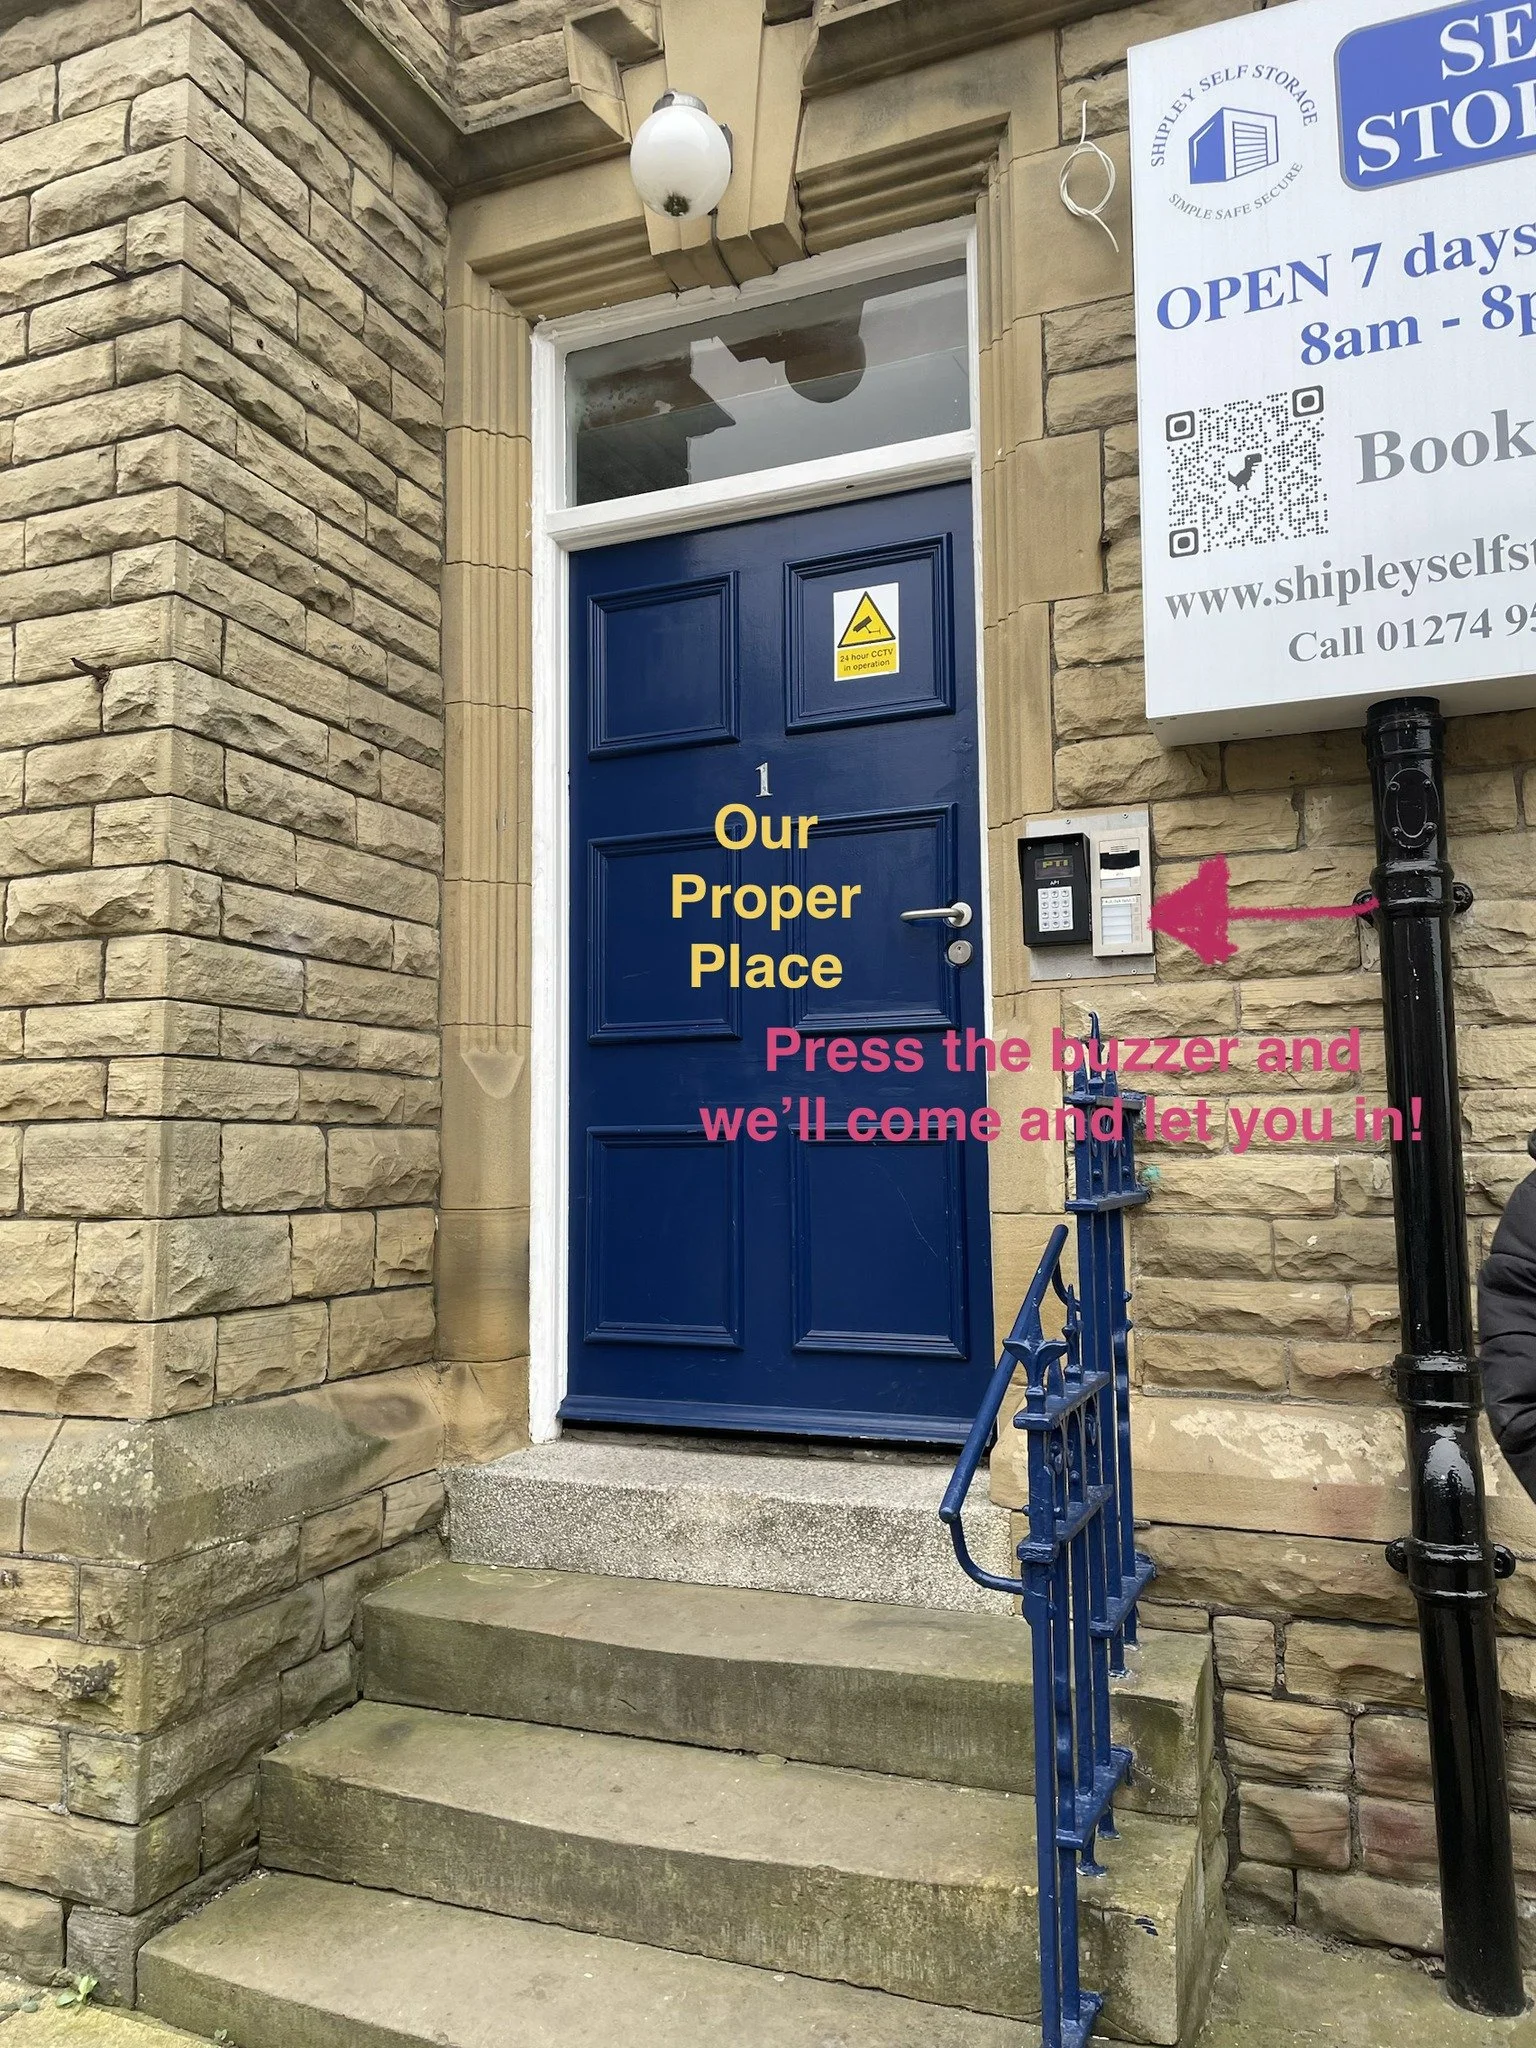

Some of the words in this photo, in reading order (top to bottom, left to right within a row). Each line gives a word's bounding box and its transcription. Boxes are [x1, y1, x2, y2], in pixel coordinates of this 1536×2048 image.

[1440, 3, 1536, 80] SE
[1151, 88, 1196, 167] SHIPLEY
[1199, 64, 1249, 92] SELF
[1252, 64, 1318, 127] STORAGE
[1168, 193, 1212, 220] SIMPLE
[1215, 203, 1252, 220] SAFE
[1254, 162, 1303, 209] SECURE
[1156, 253, 1332, 330] OPEN
[1351, 242, 1383, 289] 7
[1403, 222, 1536, 278] days
[1300, 313, 1422, 366] 8am
[1442, 317, 1460, 329] -
[1354, 409, 1536, 485] Book
[840, 655, 849, 663] 24
[851, 653, 868, 661] hour
[871, 649, 893, 658] CCTV
[1288, 625, 1364, 662] Call
[1377, 608, 1492, 652] 01274
[1505, 602, 1536, 636] 9
[853, 660, 889, 671] operation
[755, 762, 773, 798] 1
